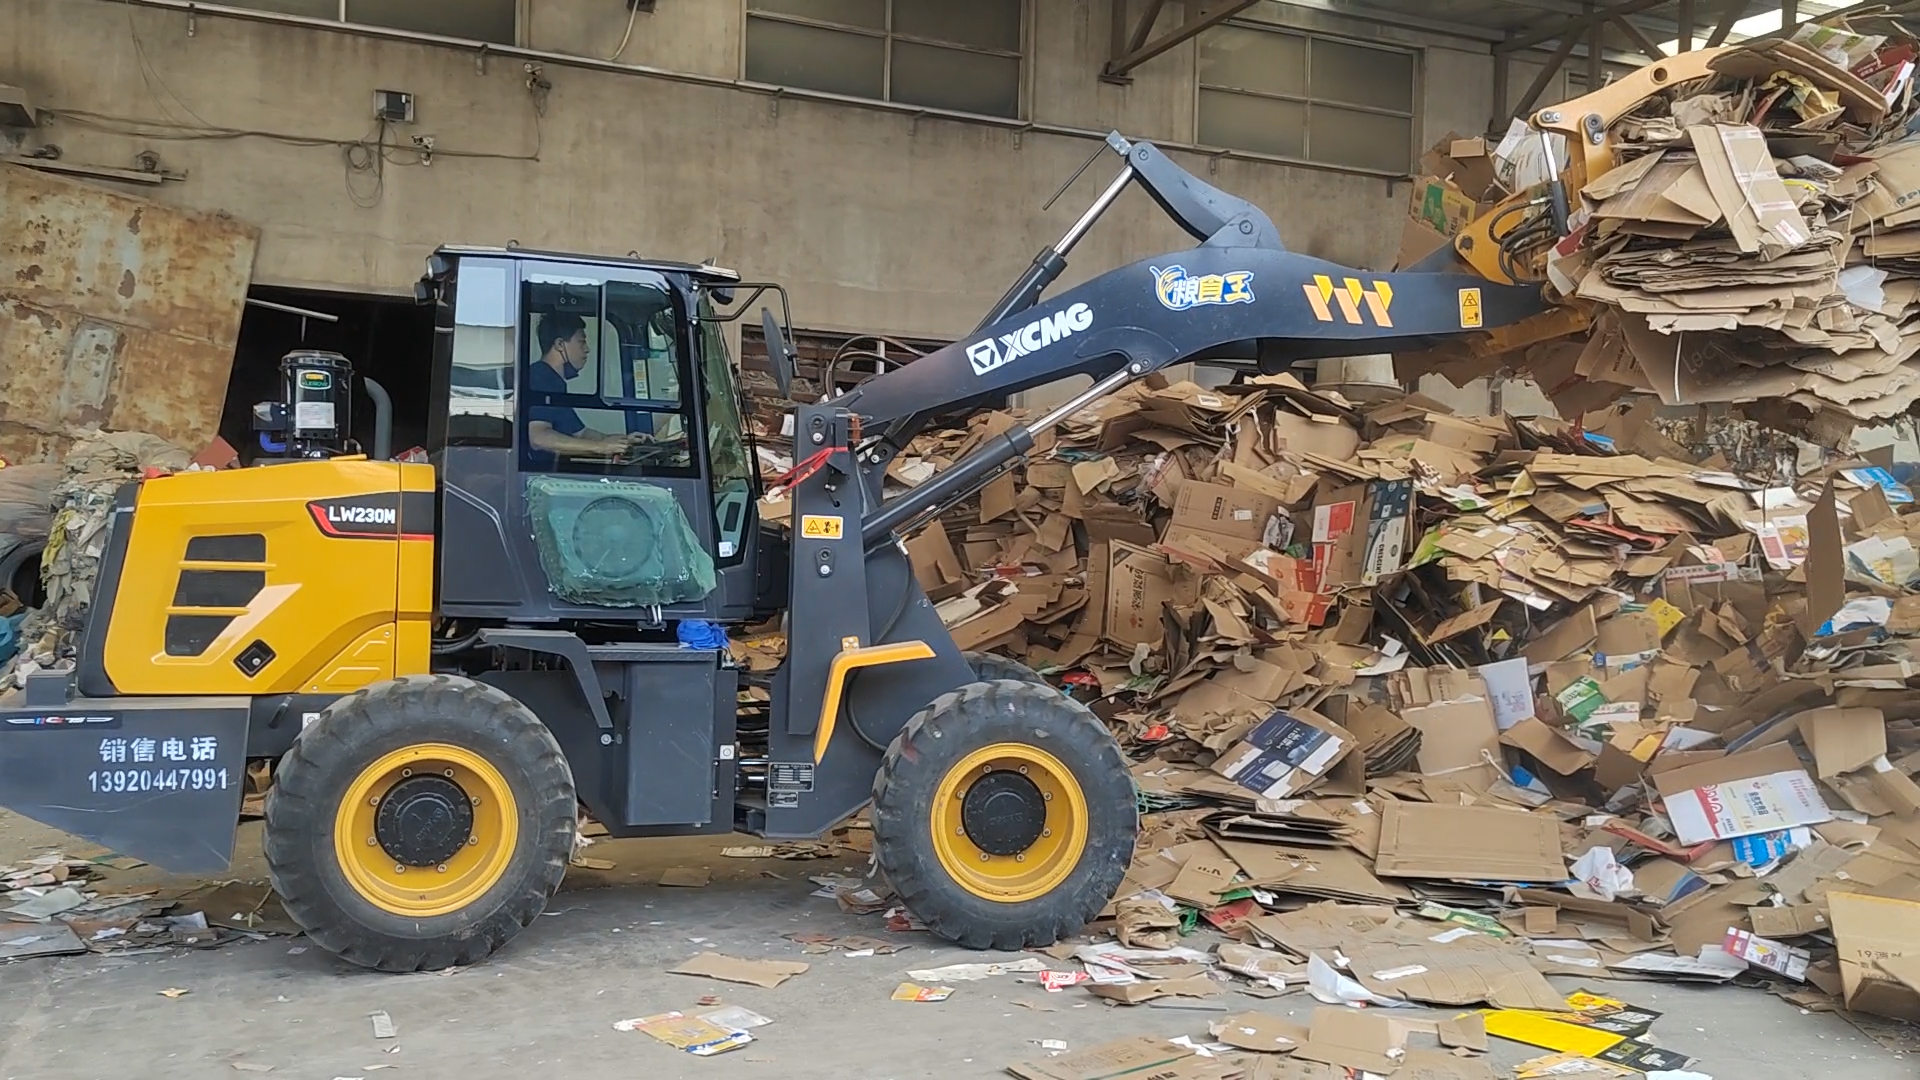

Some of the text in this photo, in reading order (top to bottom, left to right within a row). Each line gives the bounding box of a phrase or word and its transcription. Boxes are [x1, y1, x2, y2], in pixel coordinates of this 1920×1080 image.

[999, 301, 1094, 363] XCMG
[328, 505, 396, 524] LW230M
[99, 736, 218, 763] 销售电话
[88, 767, 228, 793] 13920447991
